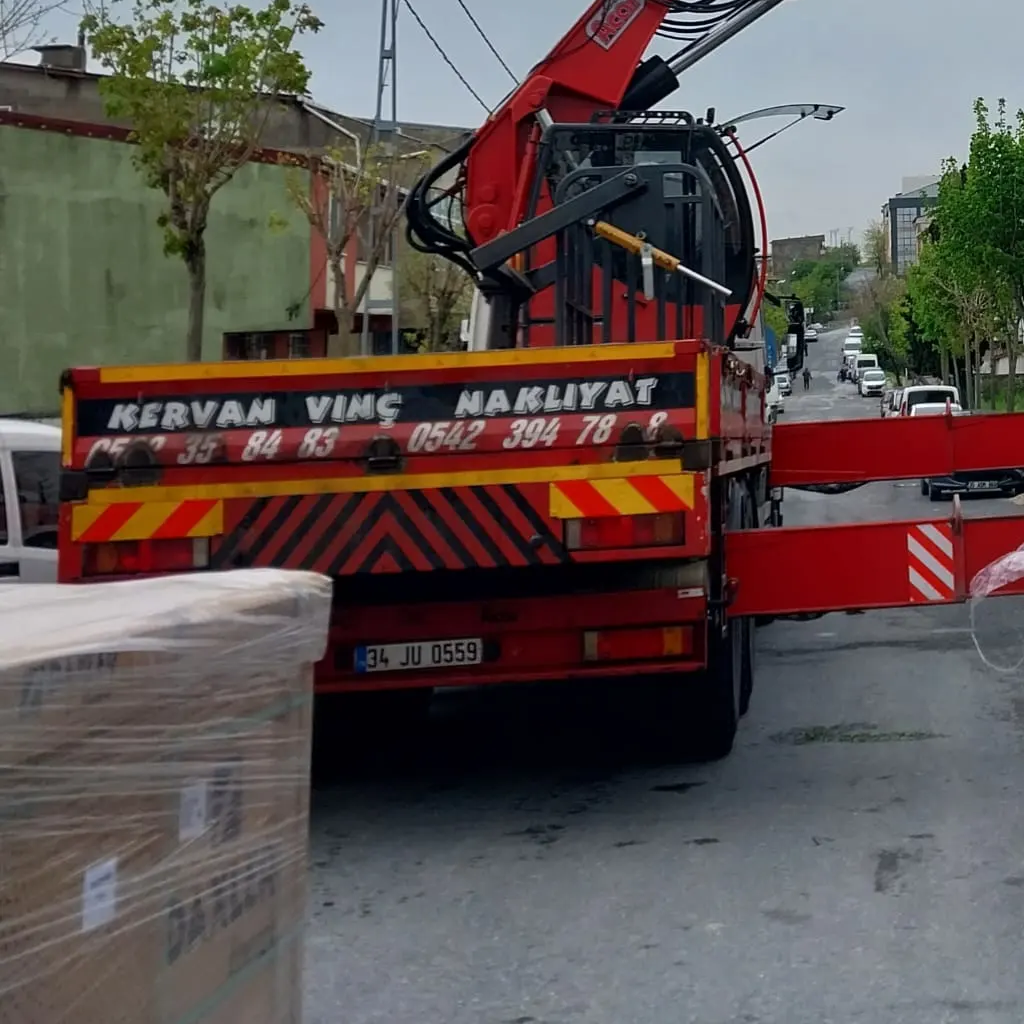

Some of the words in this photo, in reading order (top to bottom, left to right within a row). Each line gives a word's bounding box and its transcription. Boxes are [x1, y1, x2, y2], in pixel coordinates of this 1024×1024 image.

[107, 398, 276, 432] KERVAN
[454, 377, 658, 418] NAKLIYAT
[241, 429, 283, 462] 84
[297, 426, 341, 460] 83
[406, 420, 487, 453] 0542
[502, 417, 561, 449] 394
[575, 413, 618, 446] 78
[367, 647, 389, 669] 34
[400, 645, 422, 666] JU
[431, 641, 477, 664] 0559
